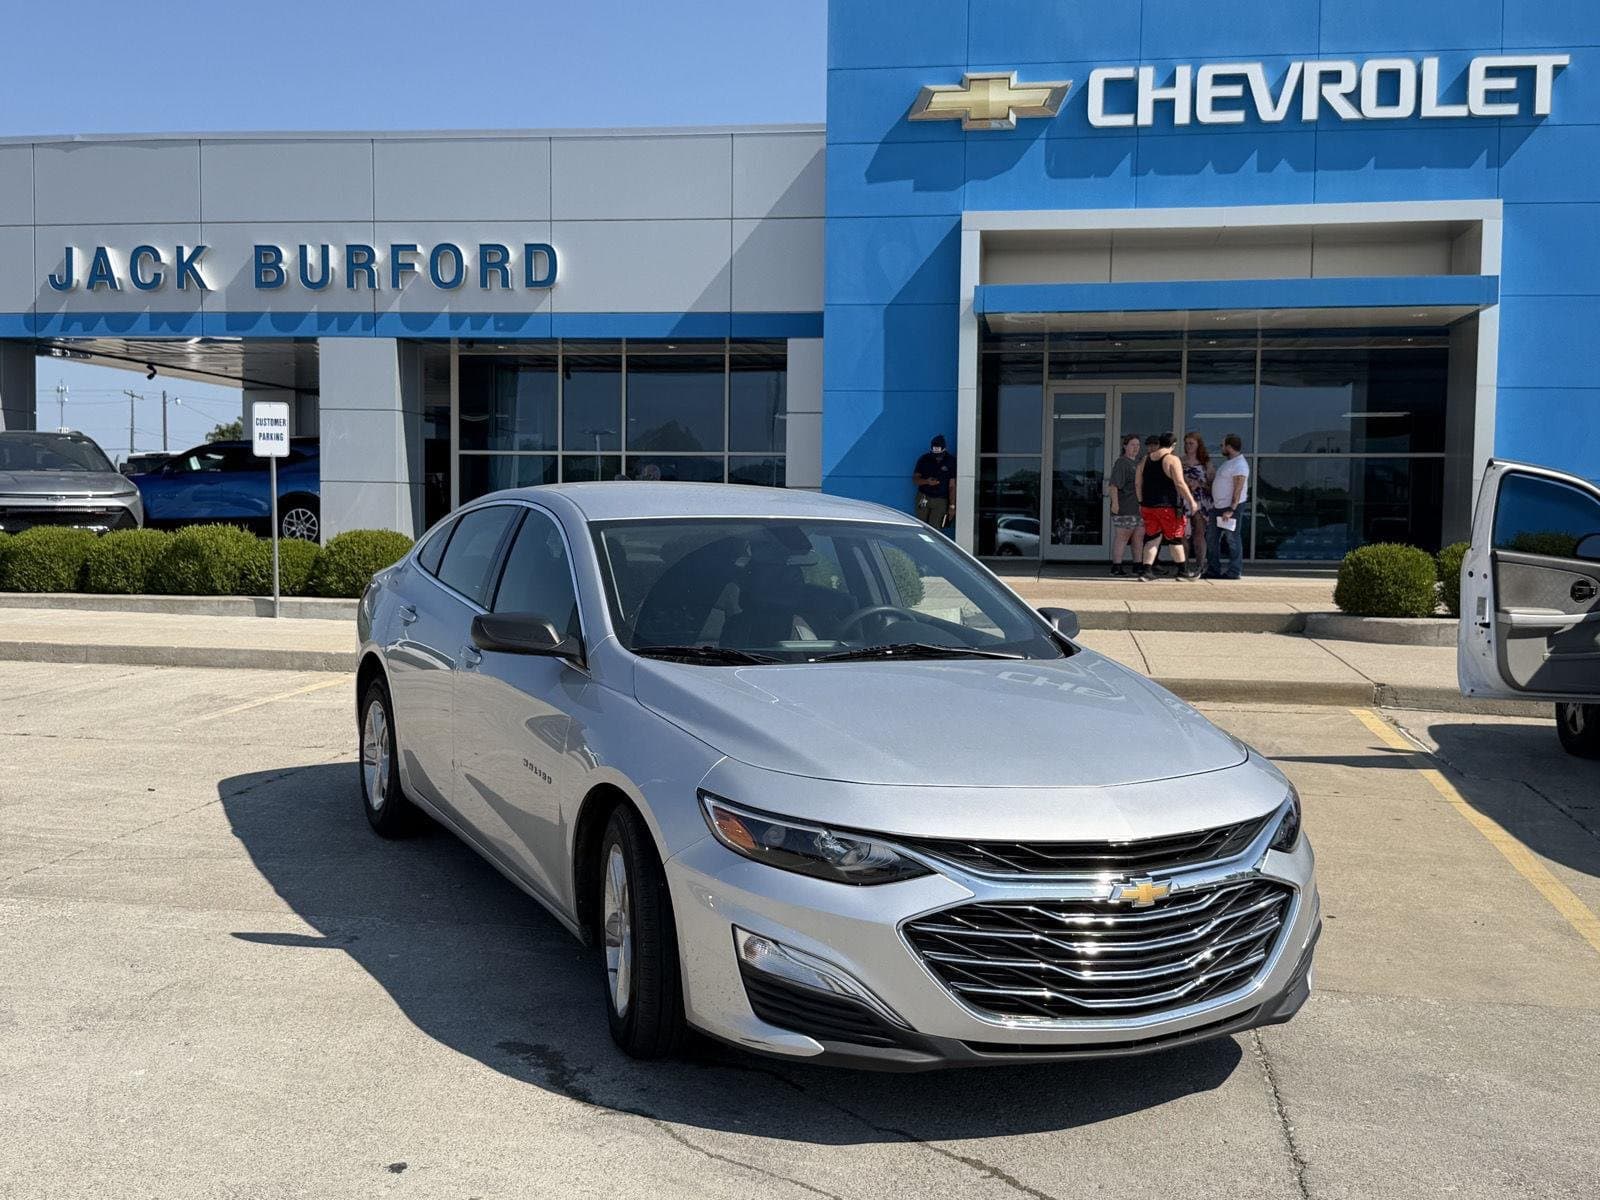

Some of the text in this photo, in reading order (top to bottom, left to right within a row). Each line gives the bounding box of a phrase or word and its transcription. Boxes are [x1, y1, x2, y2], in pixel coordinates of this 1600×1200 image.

[1088, 55, 1570, 126] CHEVROLET
[48, 243, 558, 291] JACK BURFORD
[255, 418, 286, 426] CUSTOMER
[258, 432, 284, 441] PARKING
